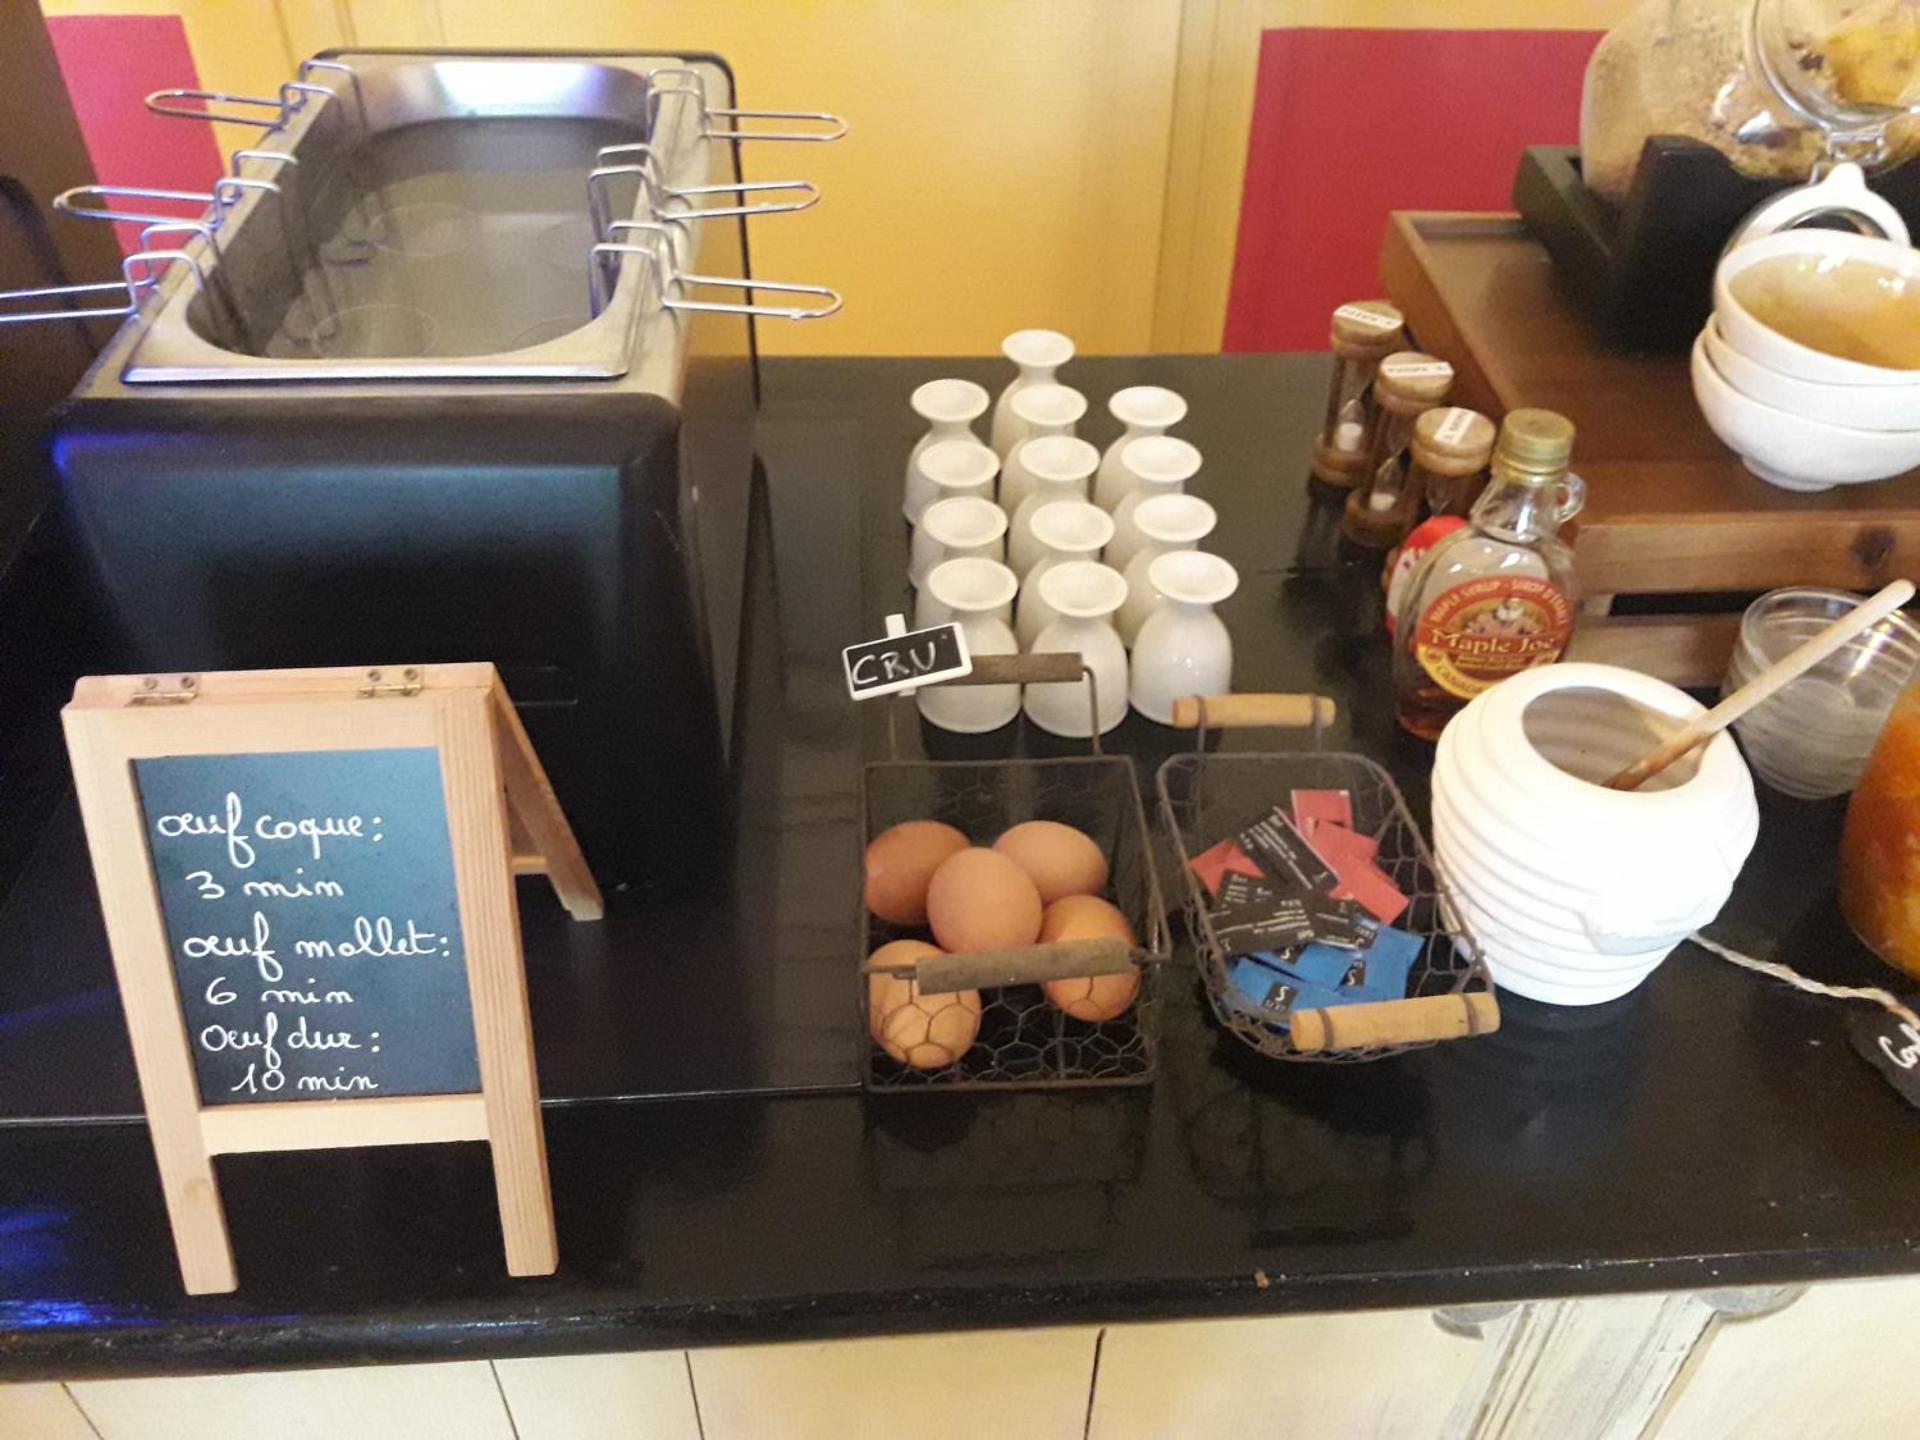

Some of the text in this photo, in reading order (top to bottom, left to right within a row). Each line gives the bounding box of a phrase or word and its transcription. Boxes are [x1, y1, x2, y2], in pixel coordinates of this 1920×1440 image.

[1430, 629, 1556, 655] Maple Joe
[852, 641, 936, 685] CRU
[184, 867, 345, 900] 3 min
[205, 977, 355, 1006] 6 min
[231, 1063, 380, 1095] 10 min
